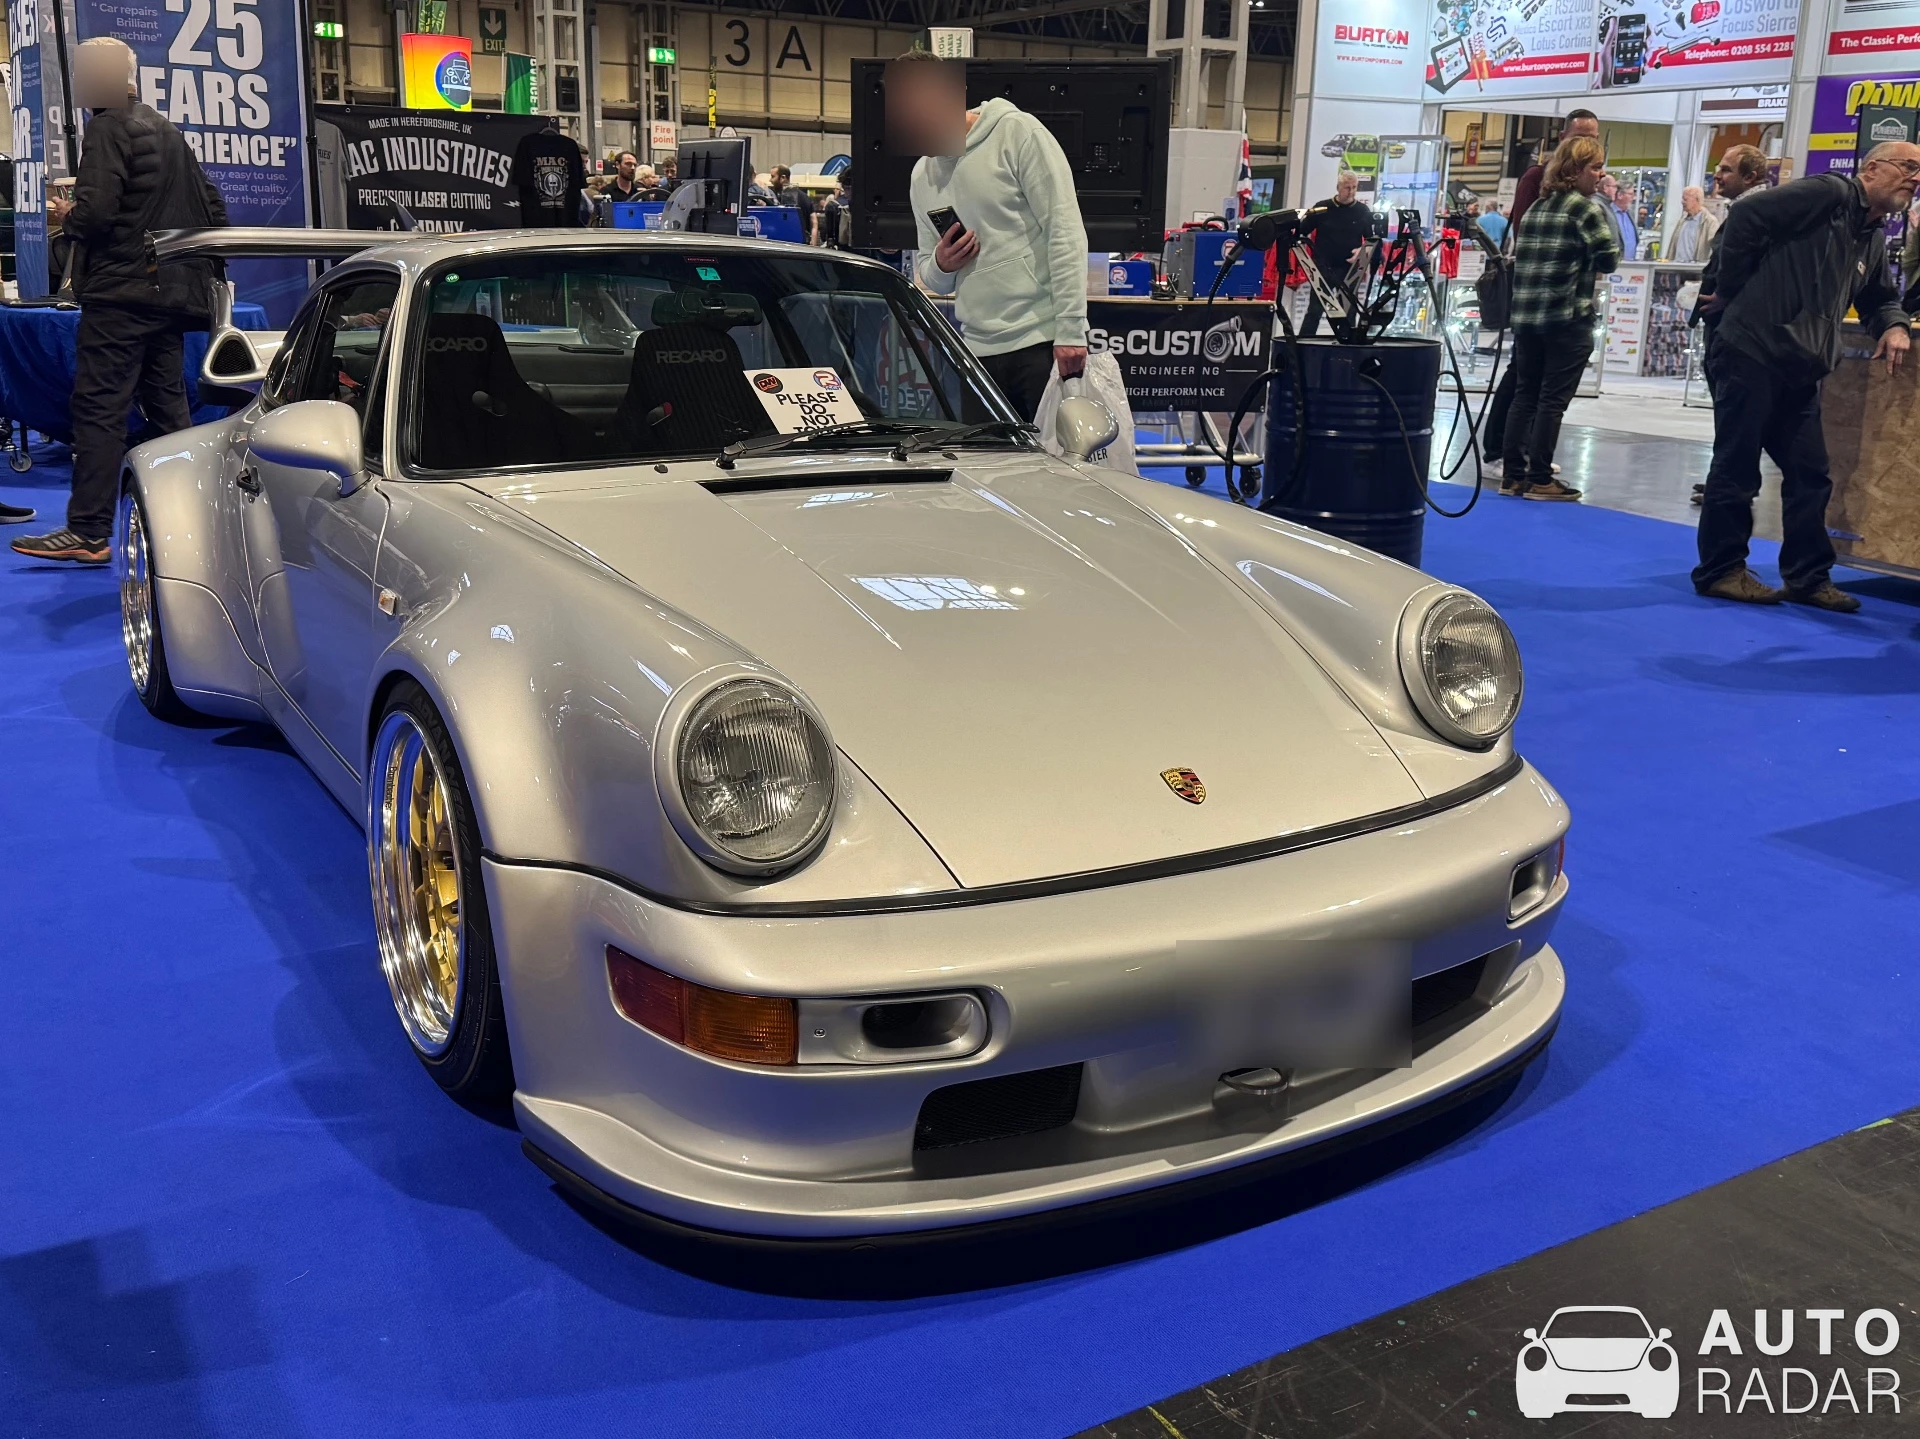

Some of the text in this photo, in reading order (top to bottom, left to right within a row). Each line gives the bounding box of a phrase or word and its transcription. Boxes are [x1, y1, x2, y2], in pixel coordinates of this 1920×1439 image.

[120, 6, 158, 17] repairs
[116, 17, 158, 29] Brilliant
[1538, 15, 1573, 33] Escort
[1721, 13, 1796, 34] Focus Sierra
[165, 0, 264, 71] 25
[1334, 24, 1409, 46] BURTON
[1531, 33, 1592, 51] Lotus Cortina
[1840, 37, 1859, 48] The
[1861, 34, 1895, 46] Classic
[485, 39, 503, 51] EXIT
[1684, 41, 1794, 60] Telephone: 0208 554 2281
[1502, 61, 1585, 73] www.burtonpower.com
[139, 66, 271, 131] EARS
[368, 117, 390, 129] MADE
[390, 117, 399, 127] IN
[462, 123, 473, 135] UK
[654, 125, 672, 134] Fire
[652, 135, 674, 145] point
[180, 130, 297, 167] RIENCE”
[347, 136, 513, 188] AC INDUSTRIES
[535, 156, 566, 167] MAC
[1829, 157, 1862, 170] ENHA
[228, 170, 252, 181] easy
[253, 171, 265, 180] to
[266, 173, 288, 181] use.
[220, 182, 289, 195] Great quality.
[225, 194, 240, 203] for
[241, 195, 259, 204] the
[414, 190, 448, 209] LASER
[450, 192, 492, 210] CUTTING
[426, 336, 488, 352] ECARO
[655, 348, 727, 364] RECARO
[1130, 366, 1220, 376] ENGINEERNG
[775, 391, 839, 406] PLEASE
[799, 403, 827, 415] DO
[800, 413, 838, 427] NOT
